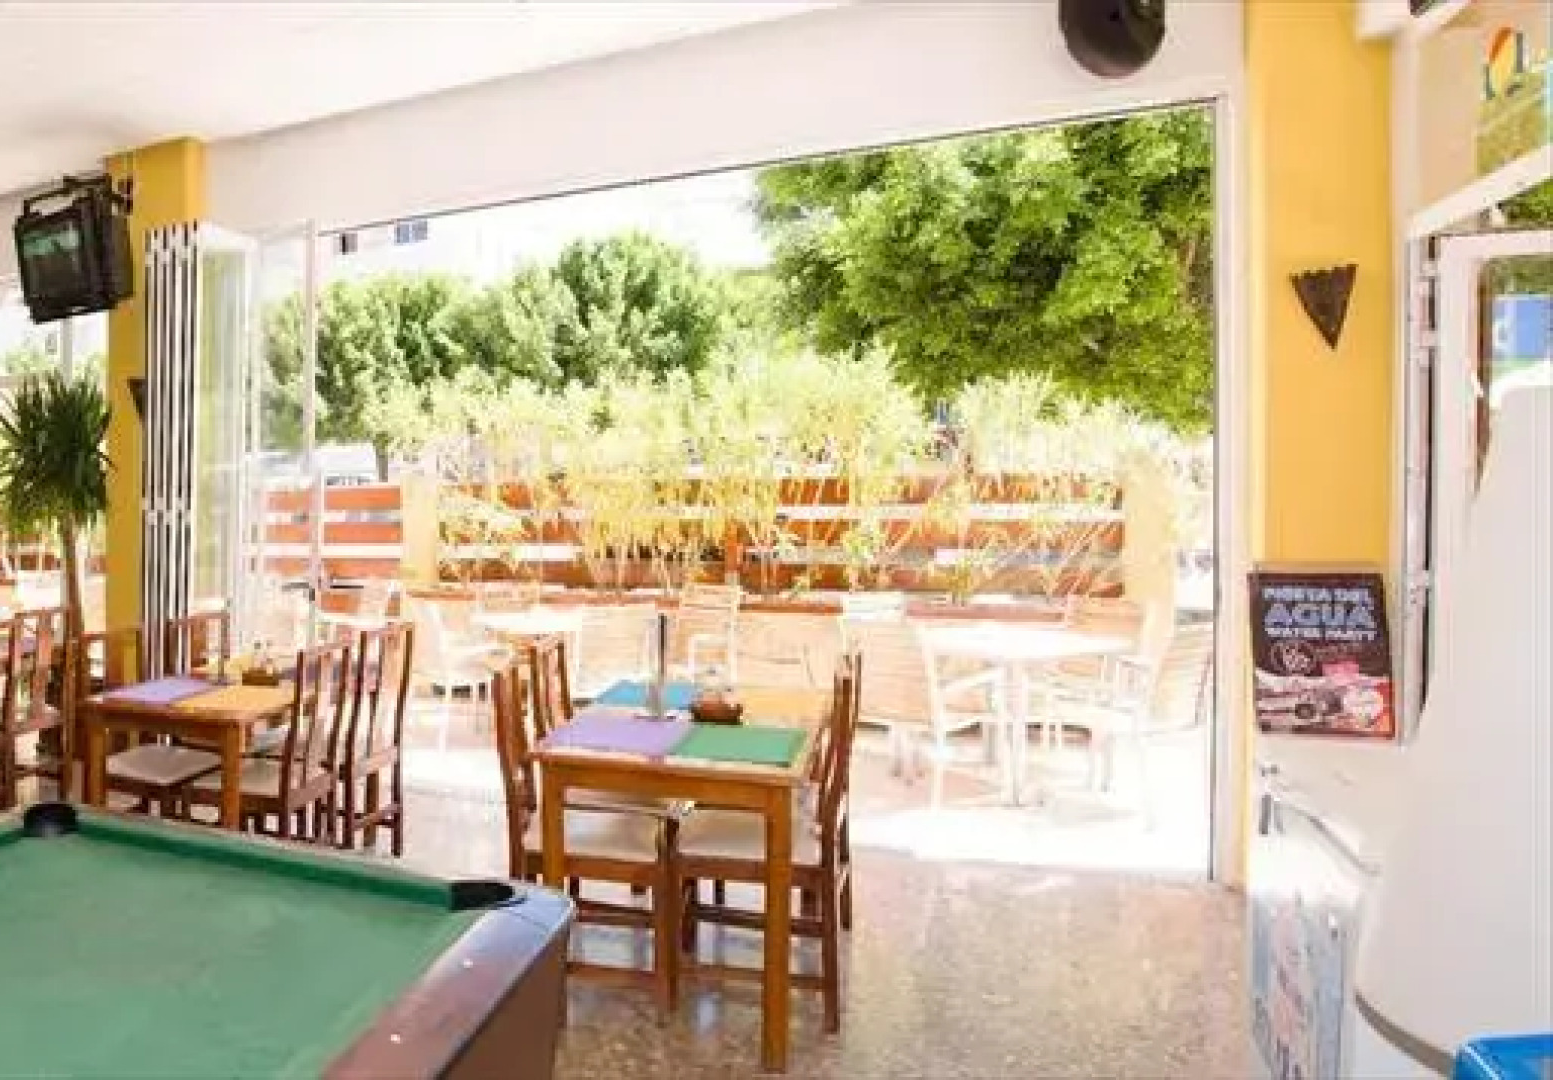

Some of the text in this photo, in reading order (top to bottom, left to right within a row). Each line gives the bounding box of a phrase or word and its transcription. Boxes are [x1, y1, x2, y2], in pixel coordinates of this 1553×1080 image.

[1264, 602, 1375, 629] AGUA
[1264, 627, 1377, 641] WATER PARTY
